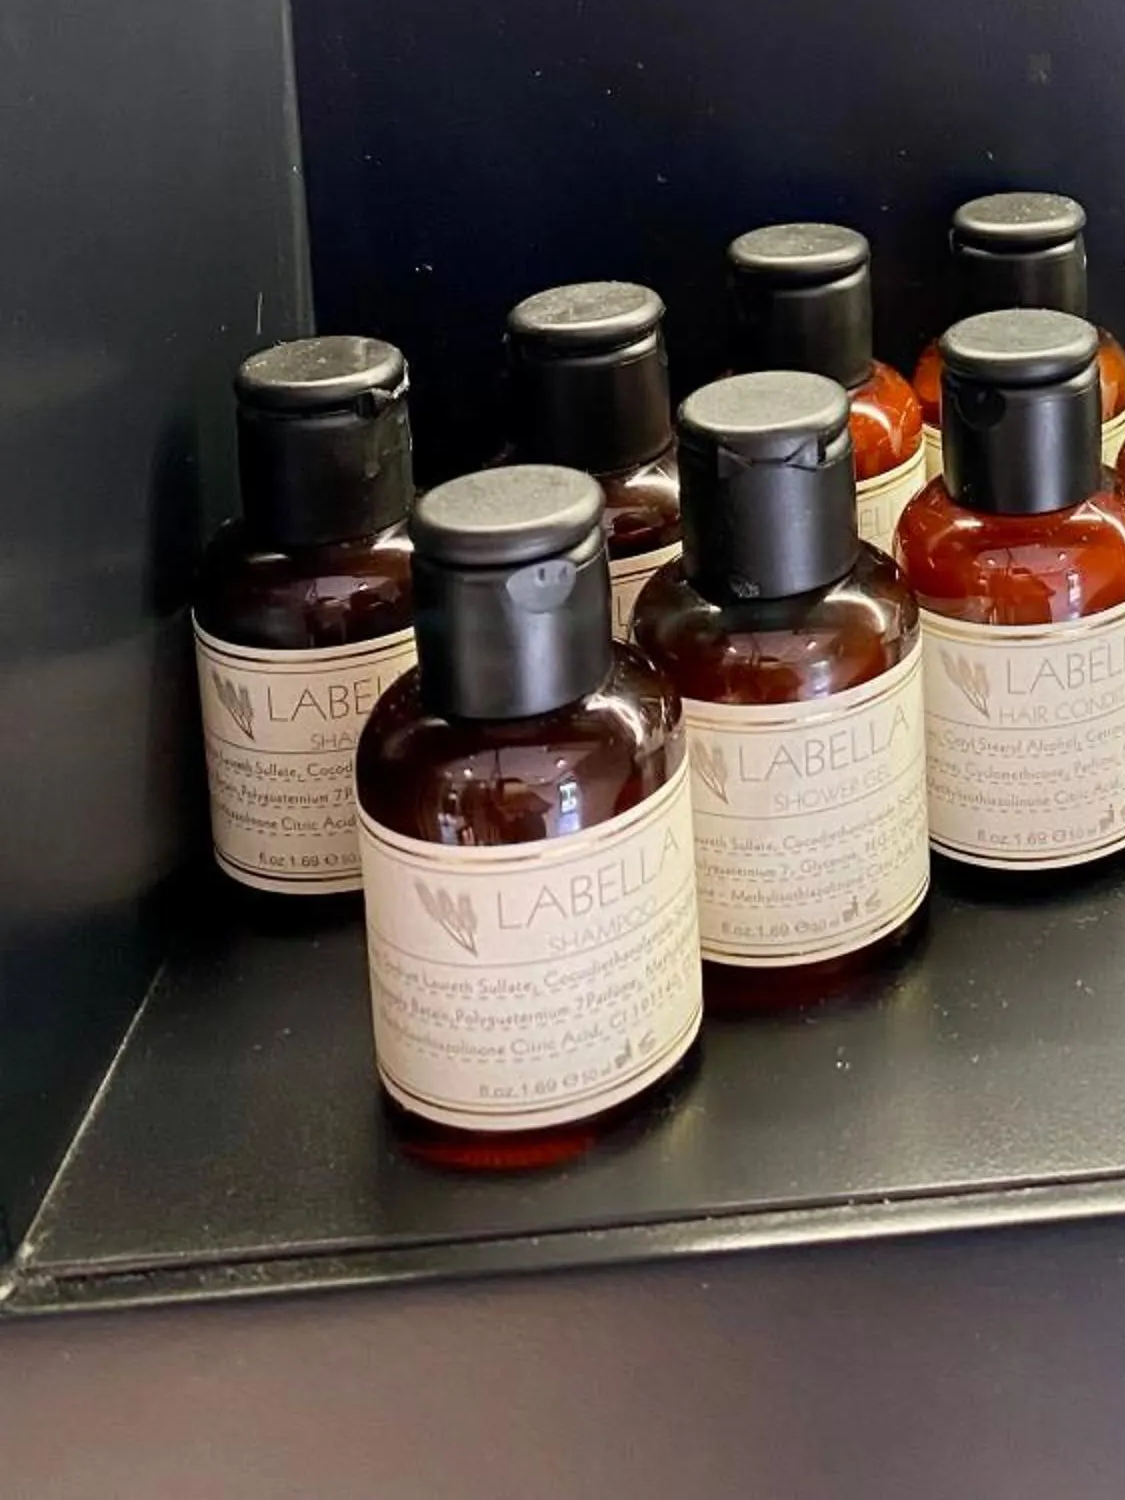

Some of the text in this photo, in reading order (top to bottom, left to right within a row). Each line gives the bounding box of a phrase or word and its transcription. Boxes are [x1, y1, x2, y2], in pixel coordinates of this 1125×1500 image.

[998, 703, 1048, 725] HAIR
[737, 705, 911, 784] LABELLA
[773, 775, 860, 812] SHOWER
[496, 825, 680, 931] LABELLA
[549, 893, 659, 953] SHAMPOO
